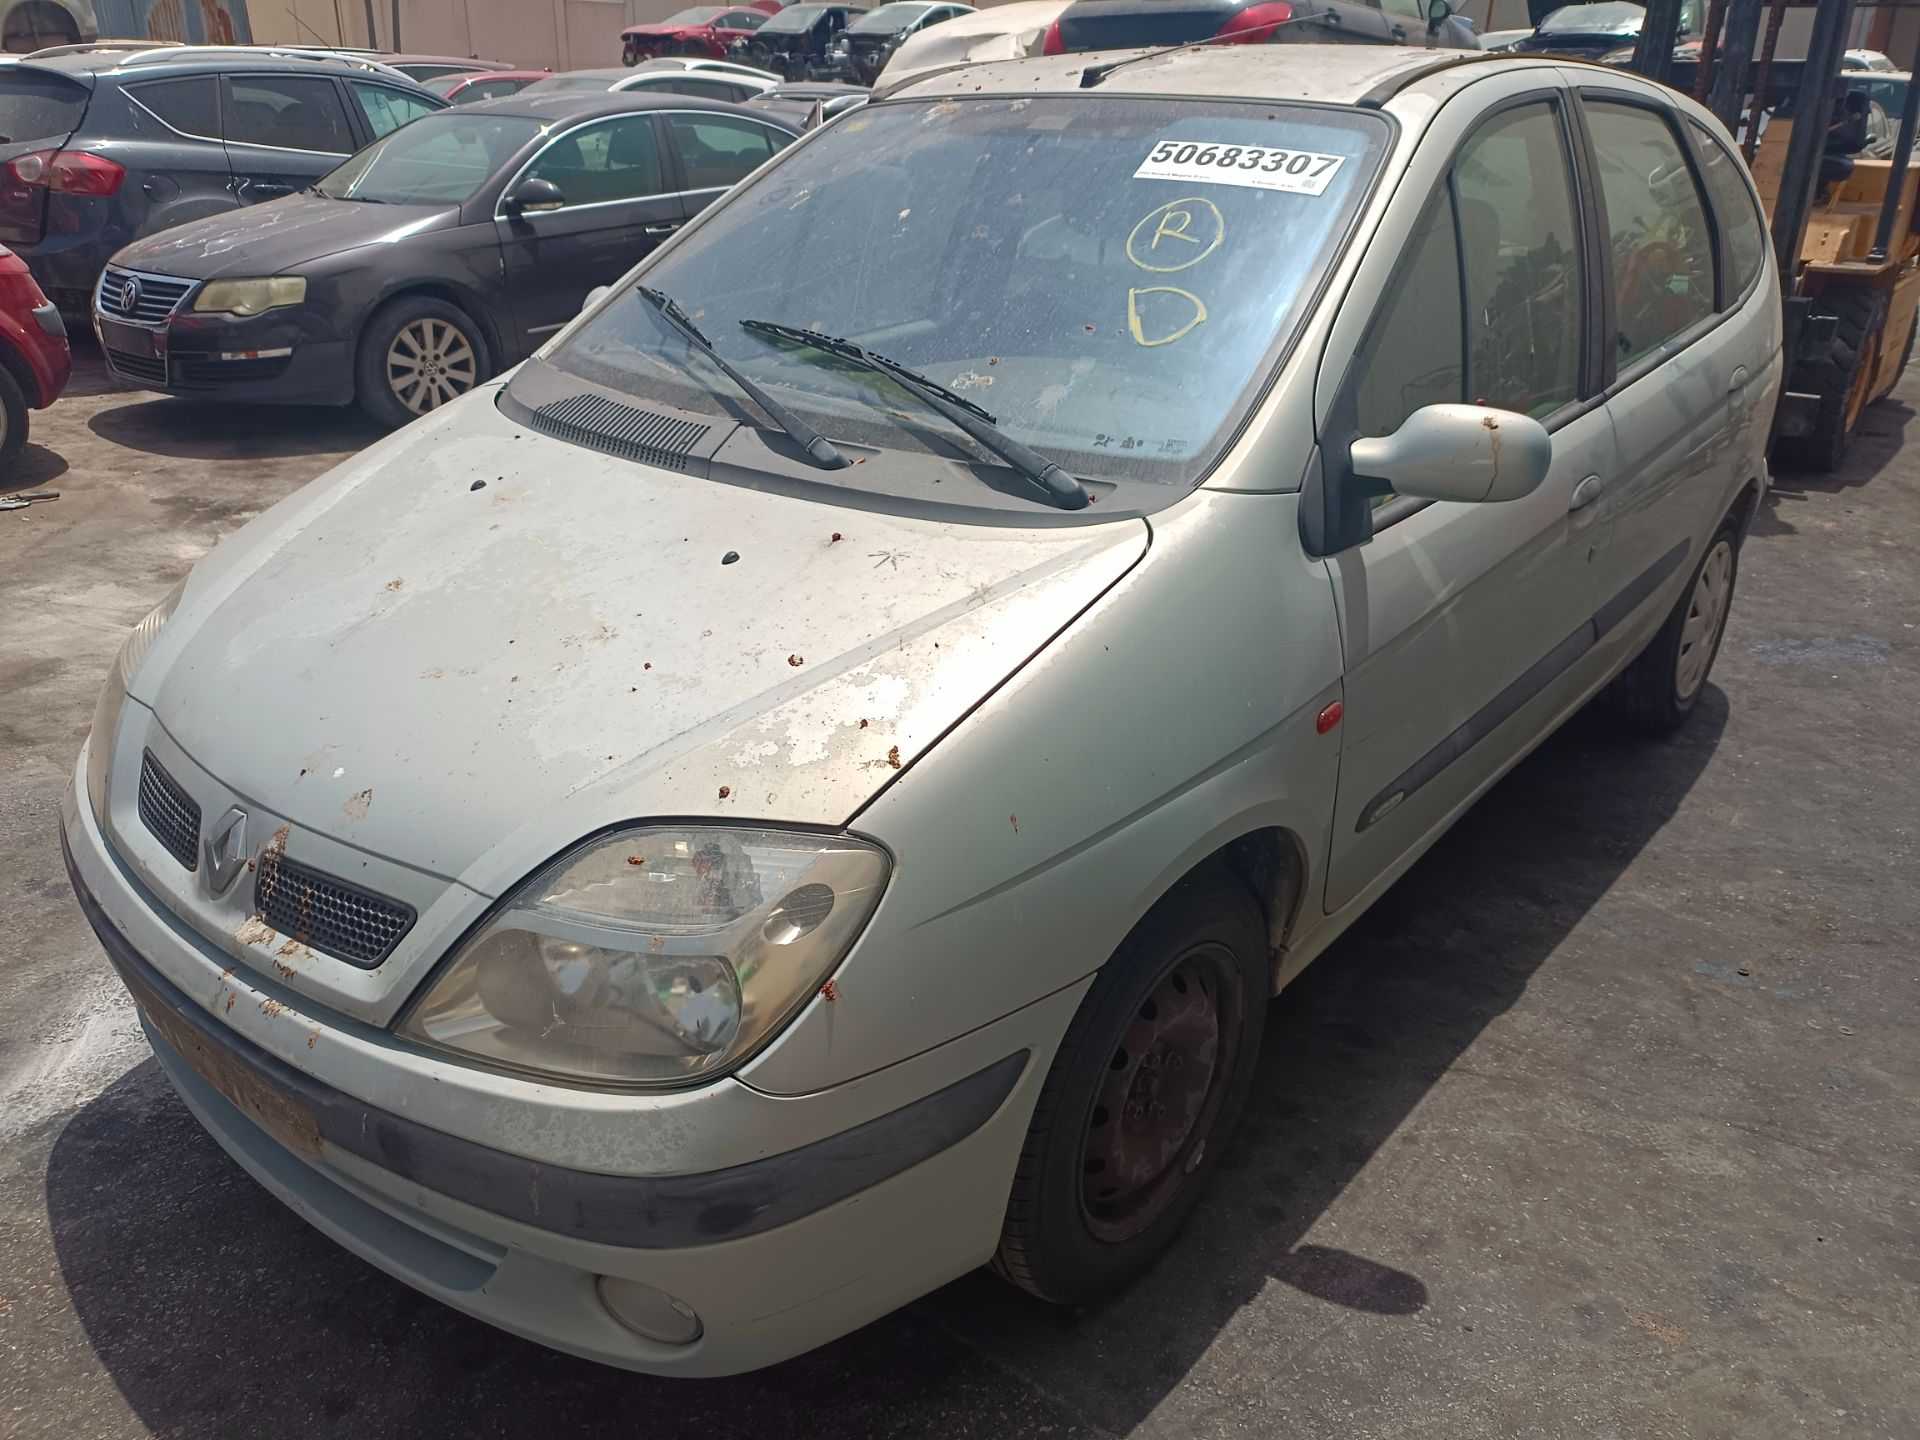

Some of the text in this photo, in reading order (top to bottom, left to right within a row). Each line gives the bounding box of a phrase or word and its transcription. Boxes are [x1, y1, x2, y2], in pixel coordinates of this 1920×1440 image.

[1151, 143, 1339, 178] 50683307
[1151, 211, 1200, 249] R
[1128, 286, 1207, 346] D
